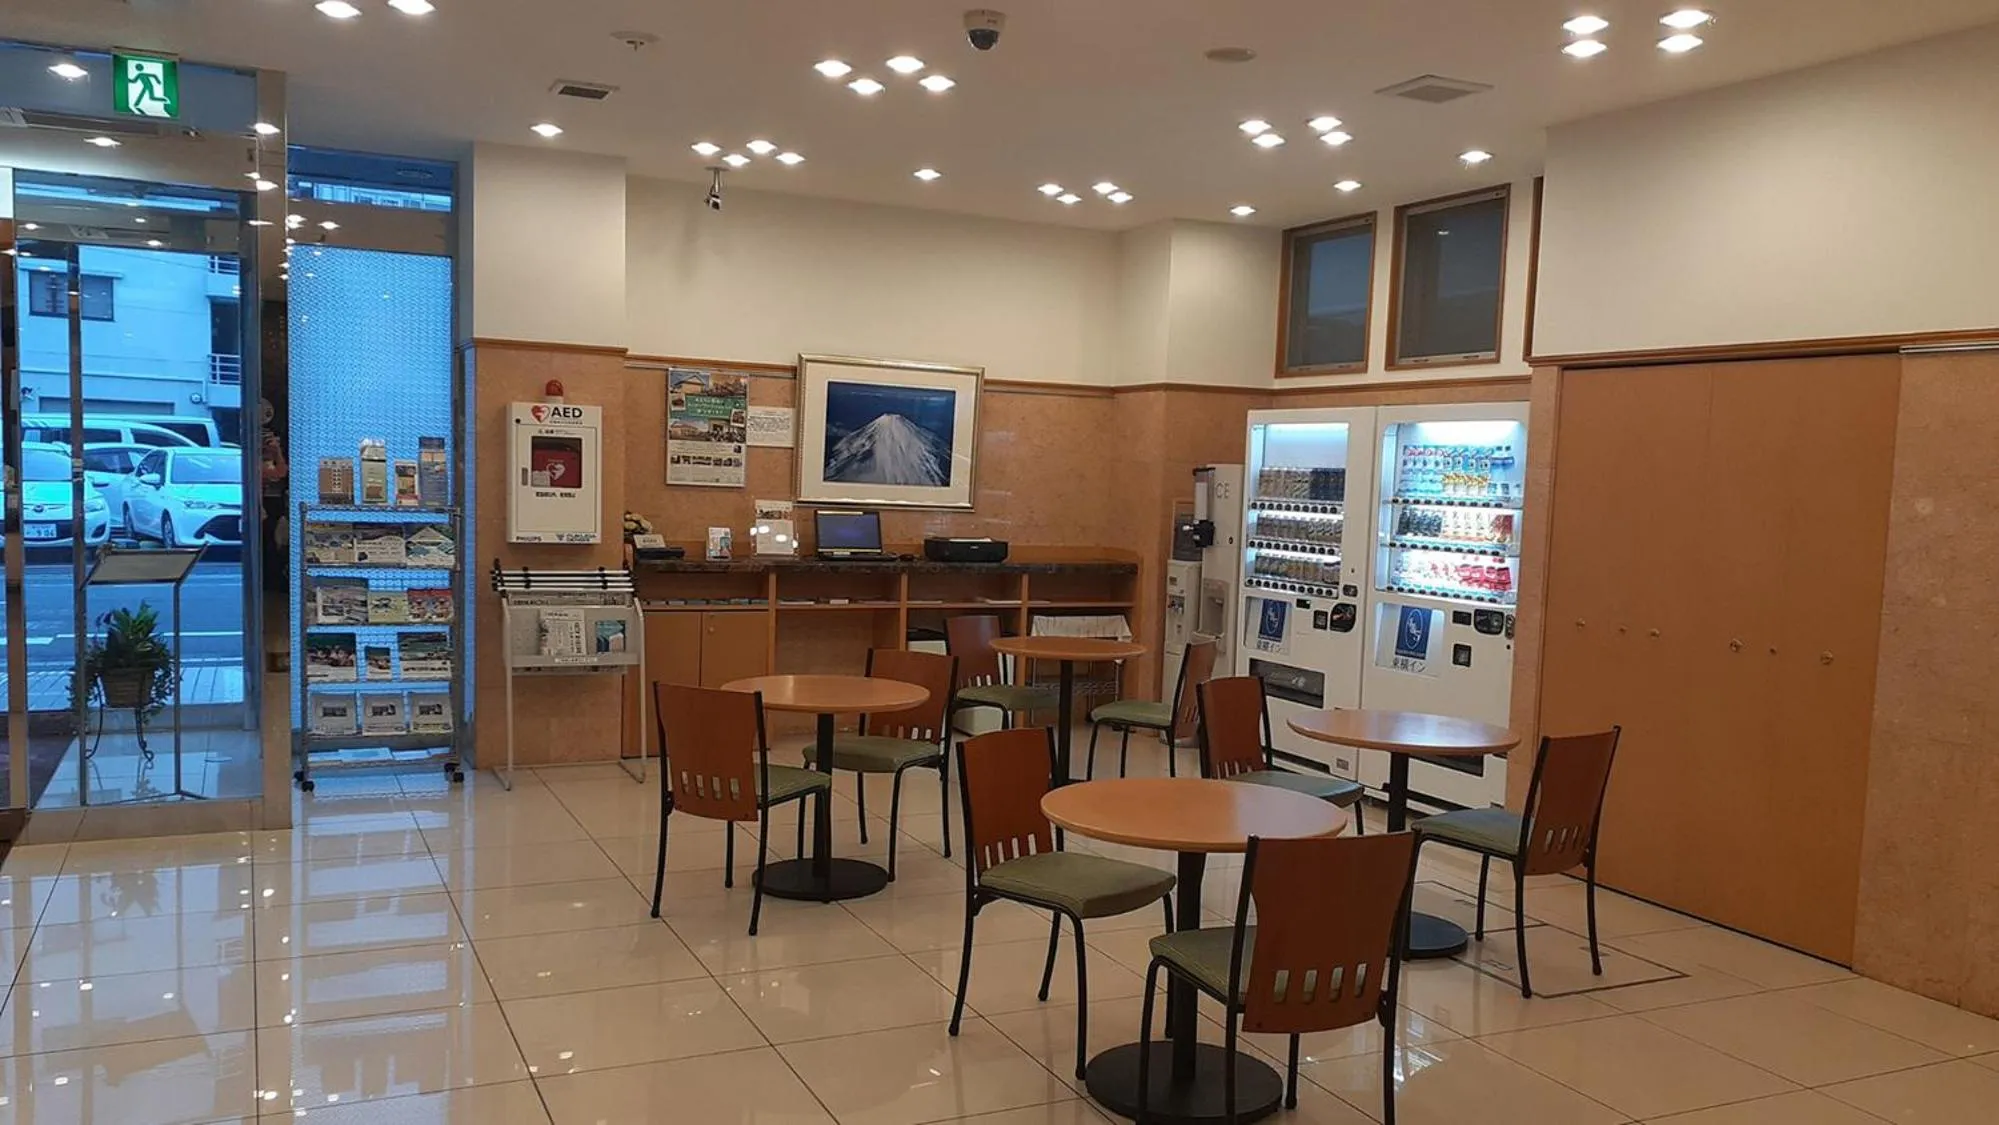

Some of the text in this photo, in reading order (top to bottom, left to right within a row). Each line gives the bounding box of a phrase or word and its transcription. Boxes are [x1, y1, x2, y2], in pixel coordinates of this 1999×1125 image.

[551, 407, 583, 418] AED
[1215, 482, 1230, 499] CE
[1391, 657, 1427, 673] 東横イン
